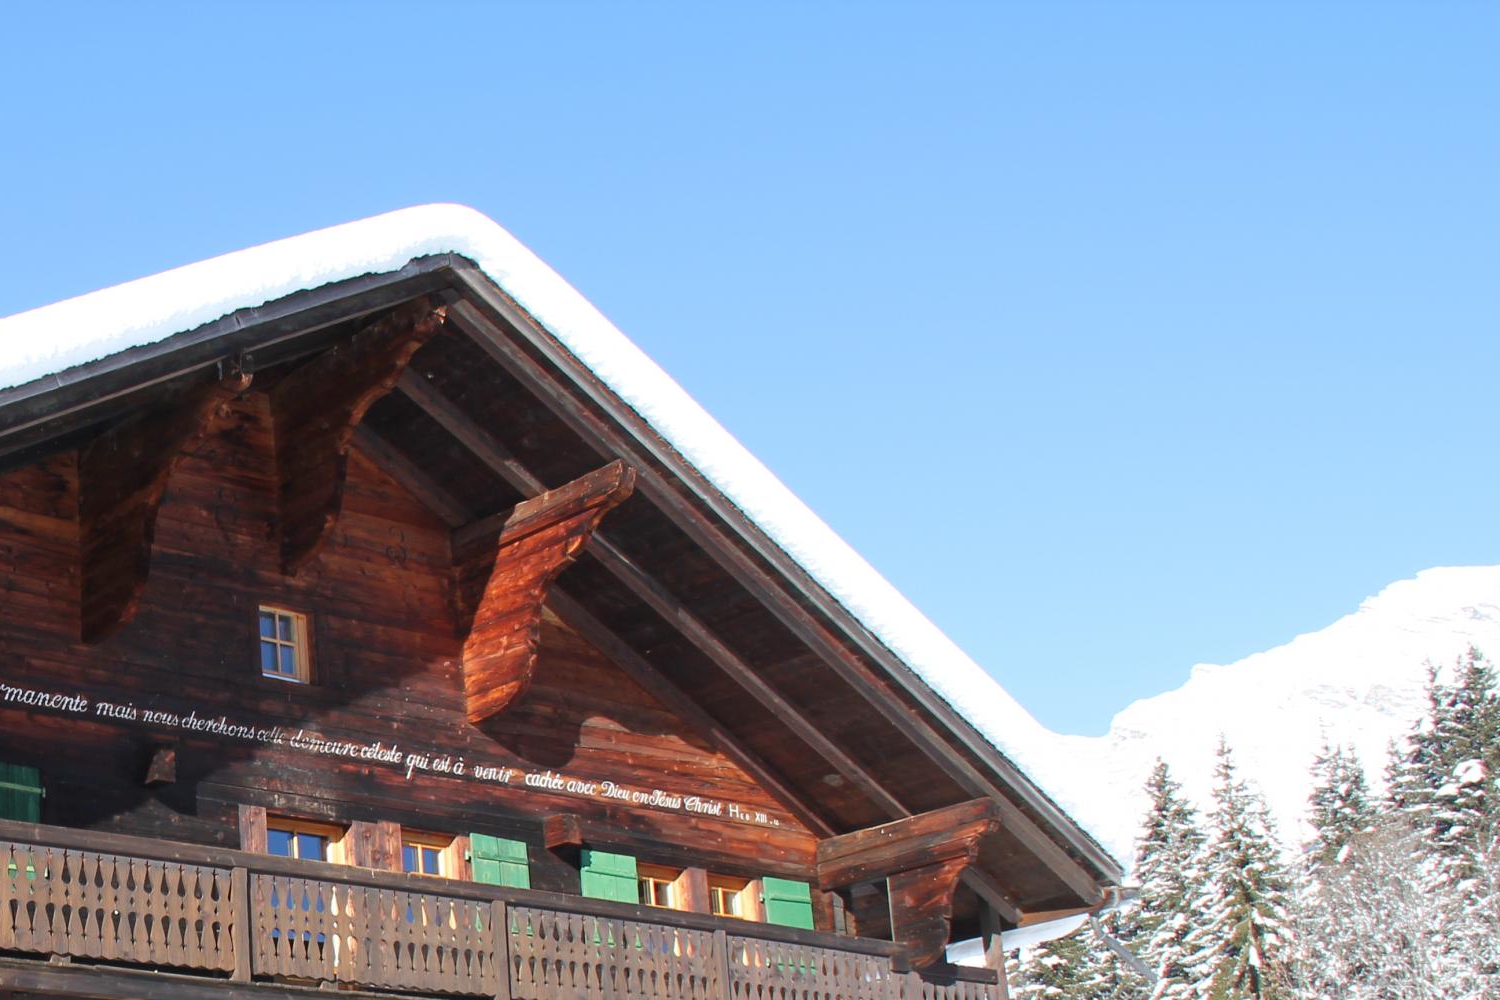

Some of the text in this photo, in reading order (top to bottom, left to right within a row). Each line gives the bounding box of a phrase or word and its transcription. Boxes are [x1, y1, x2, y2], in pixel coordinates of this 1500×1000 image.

[96, 701, 137, 721] mais
[143, 709, 179, 726] nous
[182, 711, 255, 739] cherchons
[290, 729, 359, 757] demeure
[361, 741, 402, 763] céleste
[406, 752, 430, 779] qui
[433, 755, 451, 772] est
[453, 757, 465, 776] à
[474, 763, 513, 783] venir
[525, 770, 564, 790] cachée
[567, 779, 597, 796] avec
[601, 780, 630, 800] Dieu
[632, 792, 649, 805] en
[649, 789, 681, 809] Jésus
[683, 796, 722, 816] Christ
